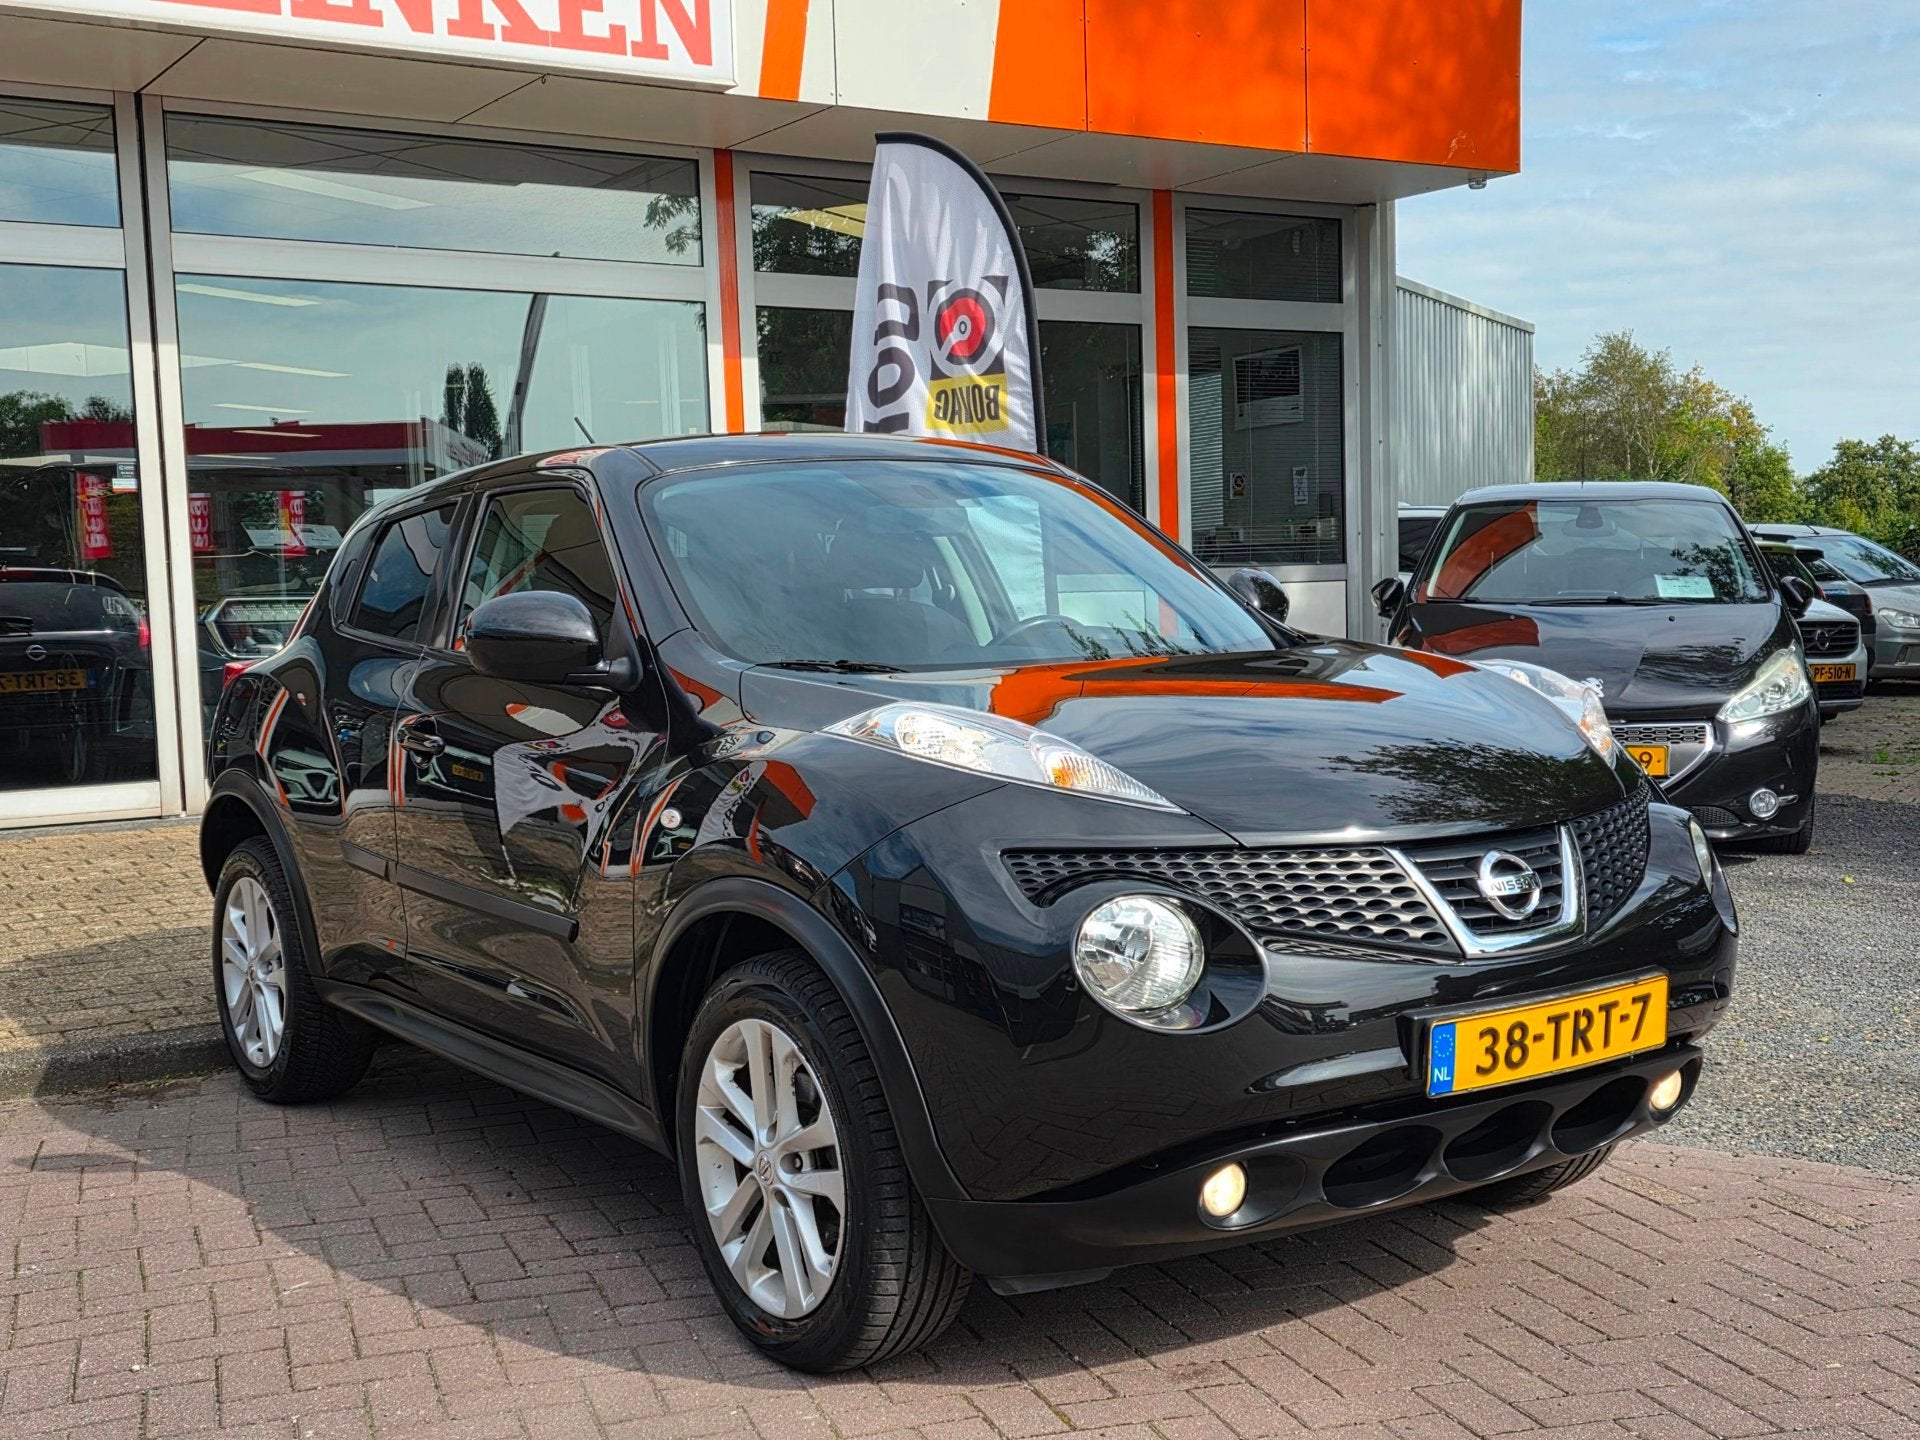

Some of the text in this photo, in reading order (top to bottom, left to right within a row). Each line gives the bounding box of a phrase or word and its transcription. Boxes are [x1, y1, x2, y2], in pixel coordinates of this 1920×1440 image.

[1814, 667, 1851, 680] PF-510-N
[1491, 875, 1538, 892] NISSAN
[1475, 992, 1653, 1077] 38-TRT-7
[1433, 1066, 1452, 1083] NL
